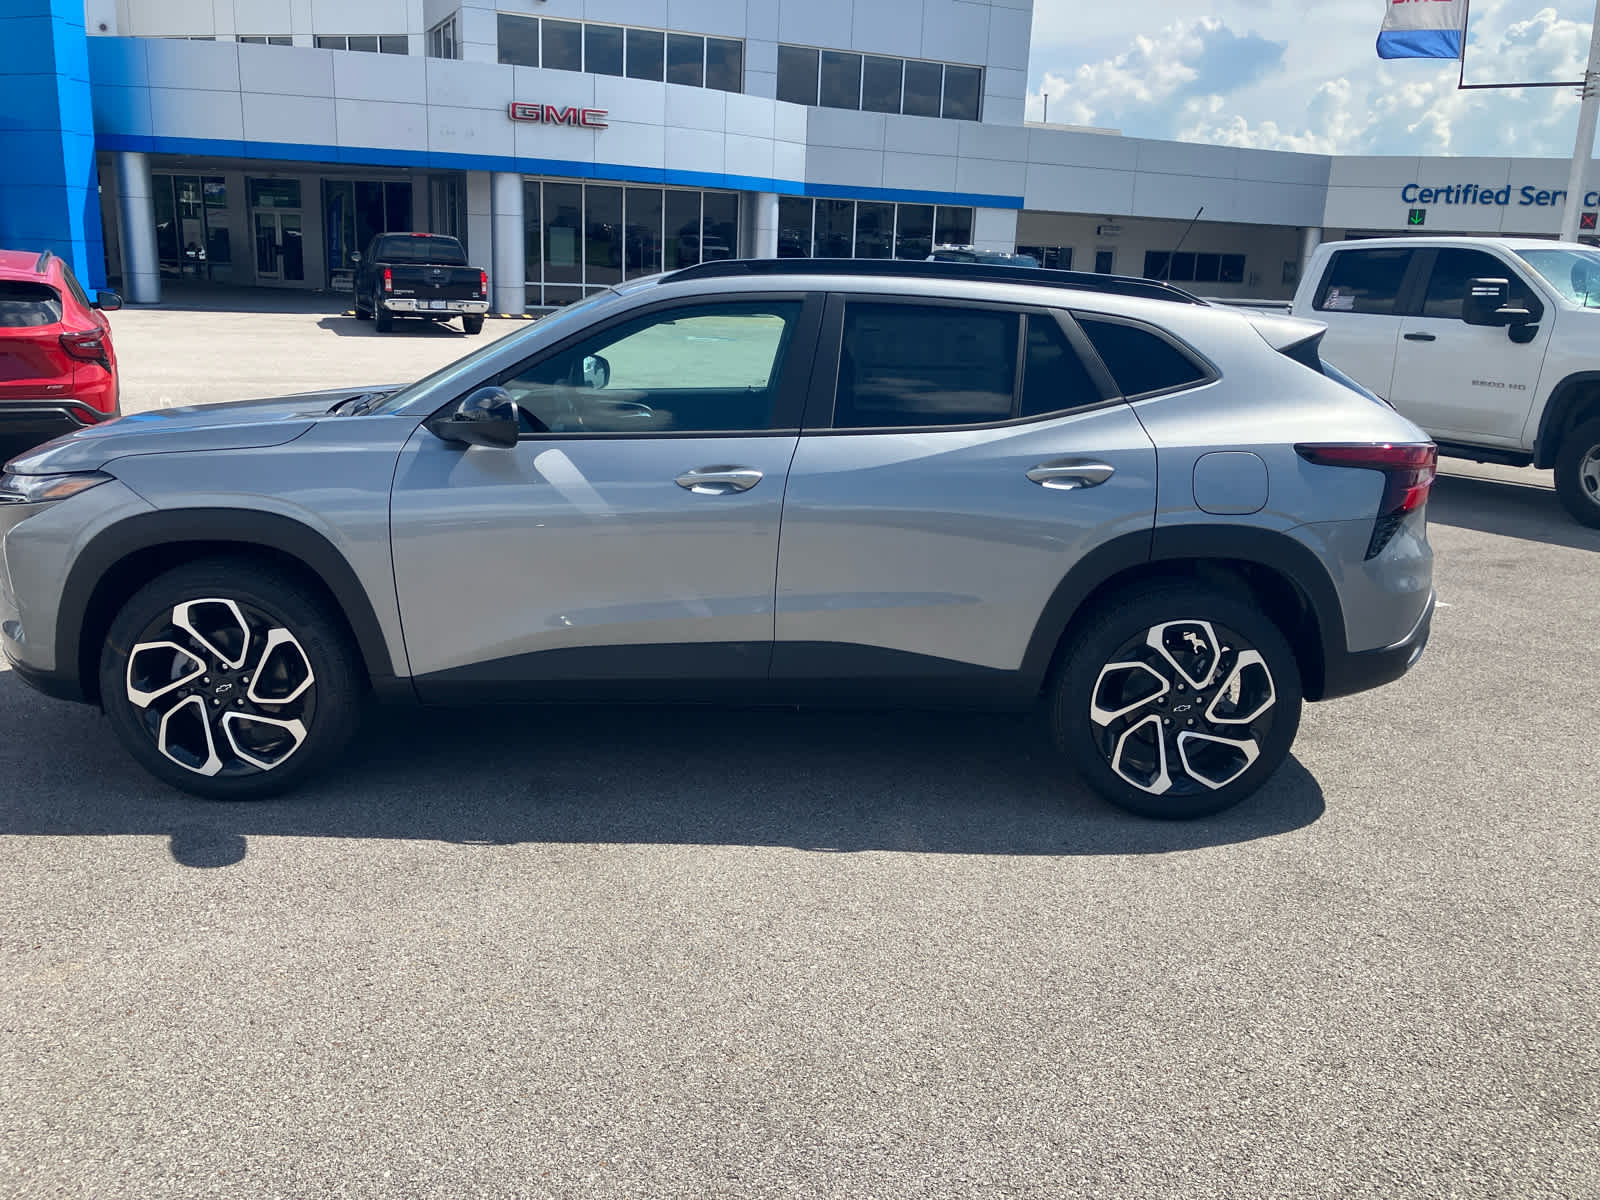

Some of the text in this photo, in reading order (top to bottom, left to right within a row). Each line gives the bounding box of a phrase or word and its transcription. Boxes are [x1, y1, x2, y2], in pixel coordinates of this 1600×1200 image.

[508, 102, 609, 128] GMC
[1401, 184, 1600, 207] Certified Serc
